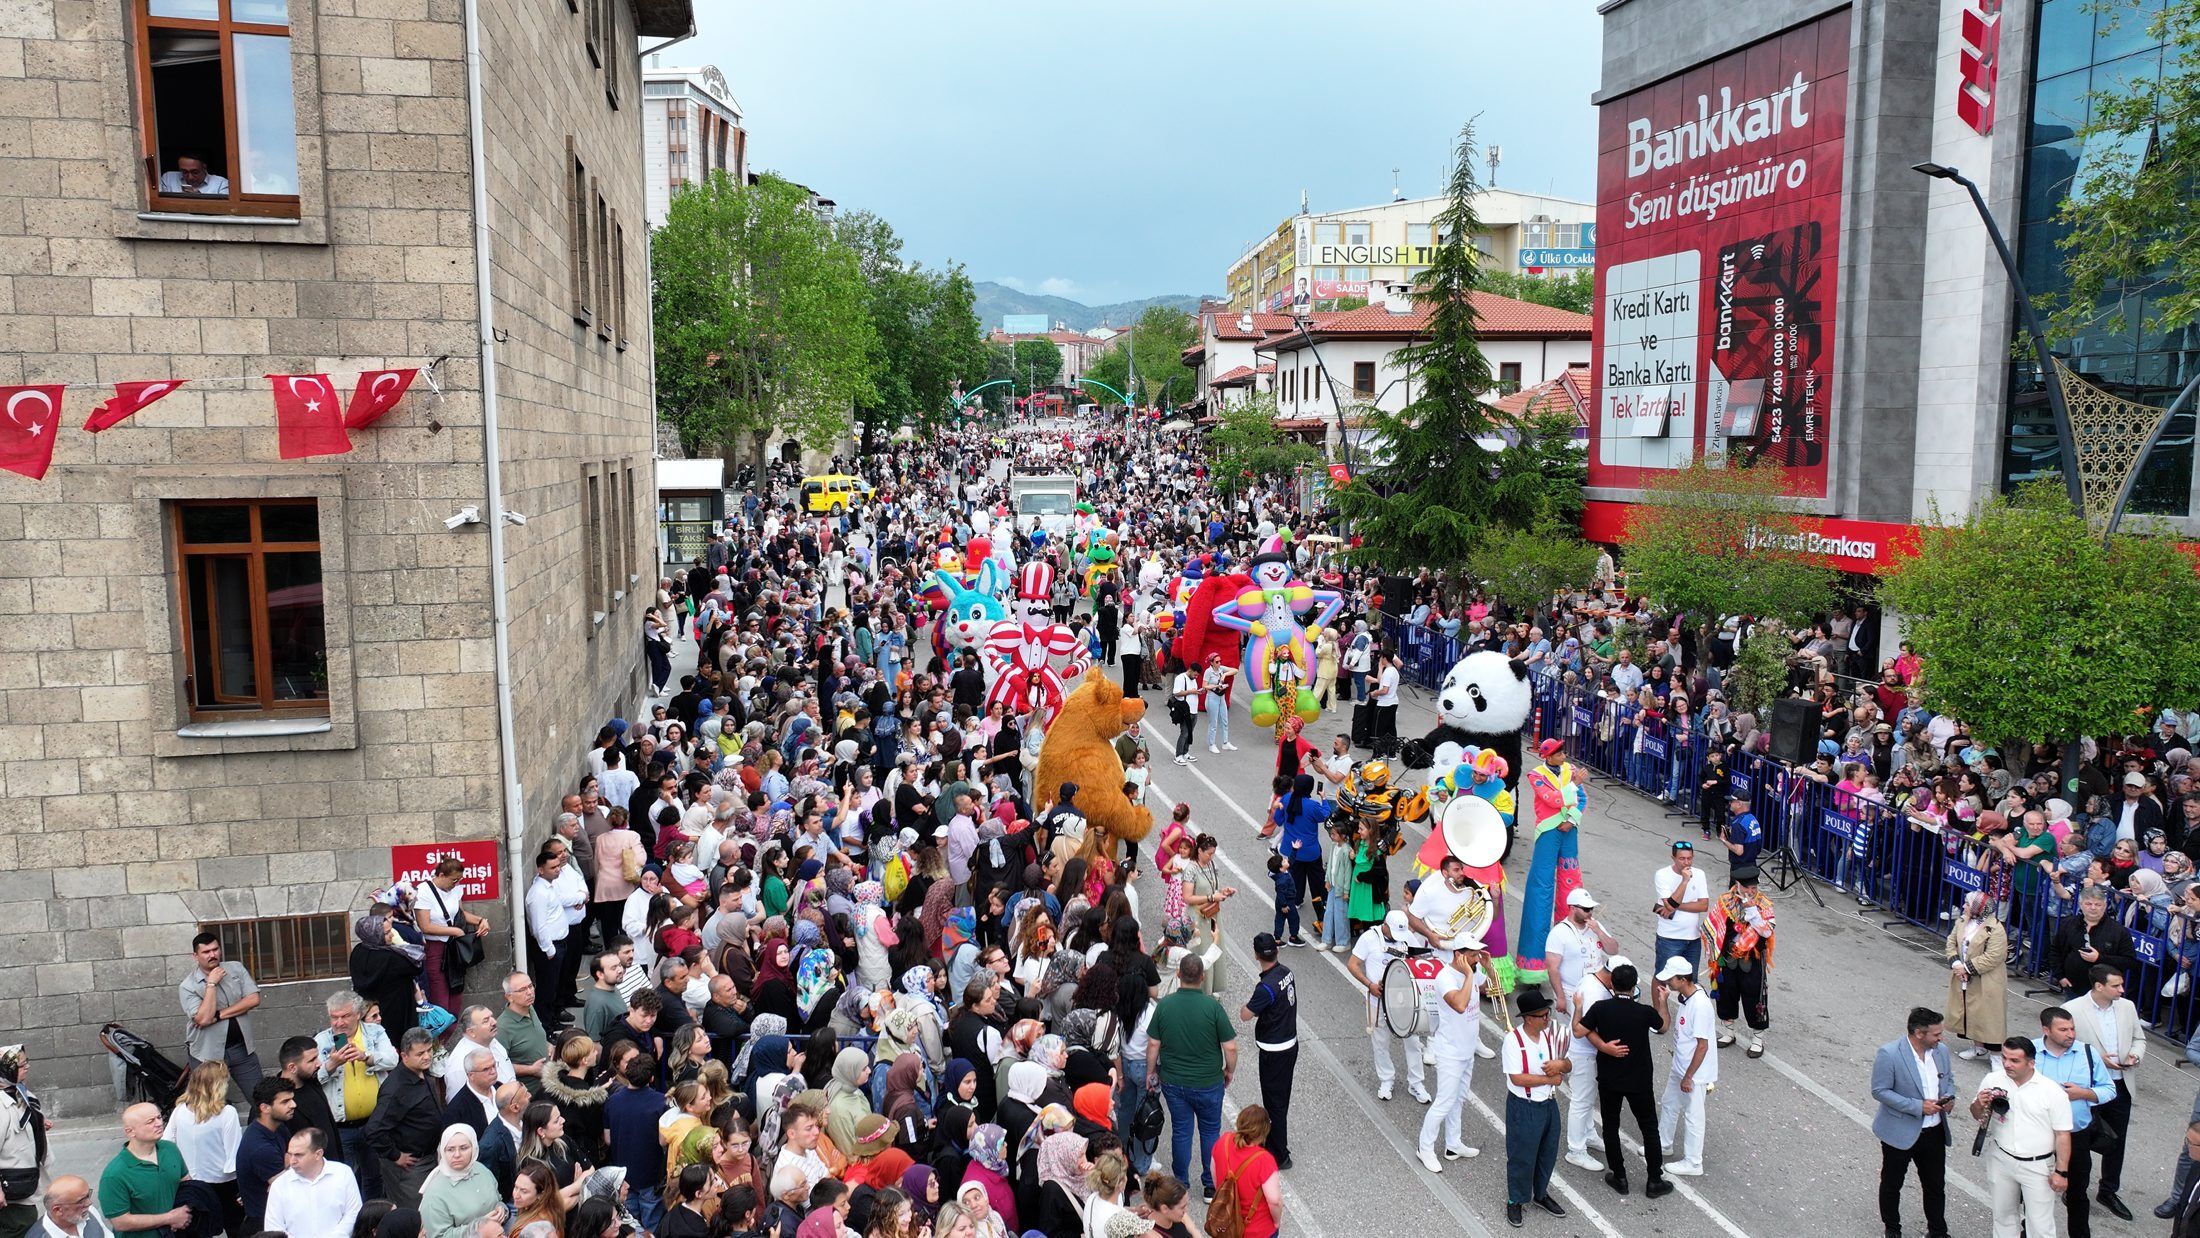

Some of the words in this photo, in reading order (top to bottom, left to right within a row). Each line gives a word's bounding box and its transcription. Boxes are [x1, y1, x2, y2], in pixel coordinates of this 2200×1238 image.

[1628, 71, 1809, 178] Bankkart
[1625, 182, 1675, 229] Seni
[1677, 156, 1784, 221] düşünür
[1786, 158, 1806, 189] o
[1322, 246, 1409, 264] ENGLISH
[1540, 251, 1560, 264] Ülkü
[1613, 293, 1650, 321] Kredi
[1654, 291, 1690, 316] Kartı
[1774, 297, 1785, 330] 0000
[1640, 335, 1657, 351] ve
[1773, 333, 1784, 366] 0000
[1789, 323, 1798, 352] 00/00
[1608, 361, 1651, 386] Banka
[1655, 359, 1691, 384] Kartı
[1772, 370, 1783, 404] 7400
[1610, 394, 1633, 419] Tek
[1772, 407, 1783, 443] 5423
[1805, 406, 1815, 441] EMRE
[675, 525, 706, 534] BİRLİK
[678, 533, 705, 542] TAKSİ
[1808, 532, 1875, 559] Bankası
